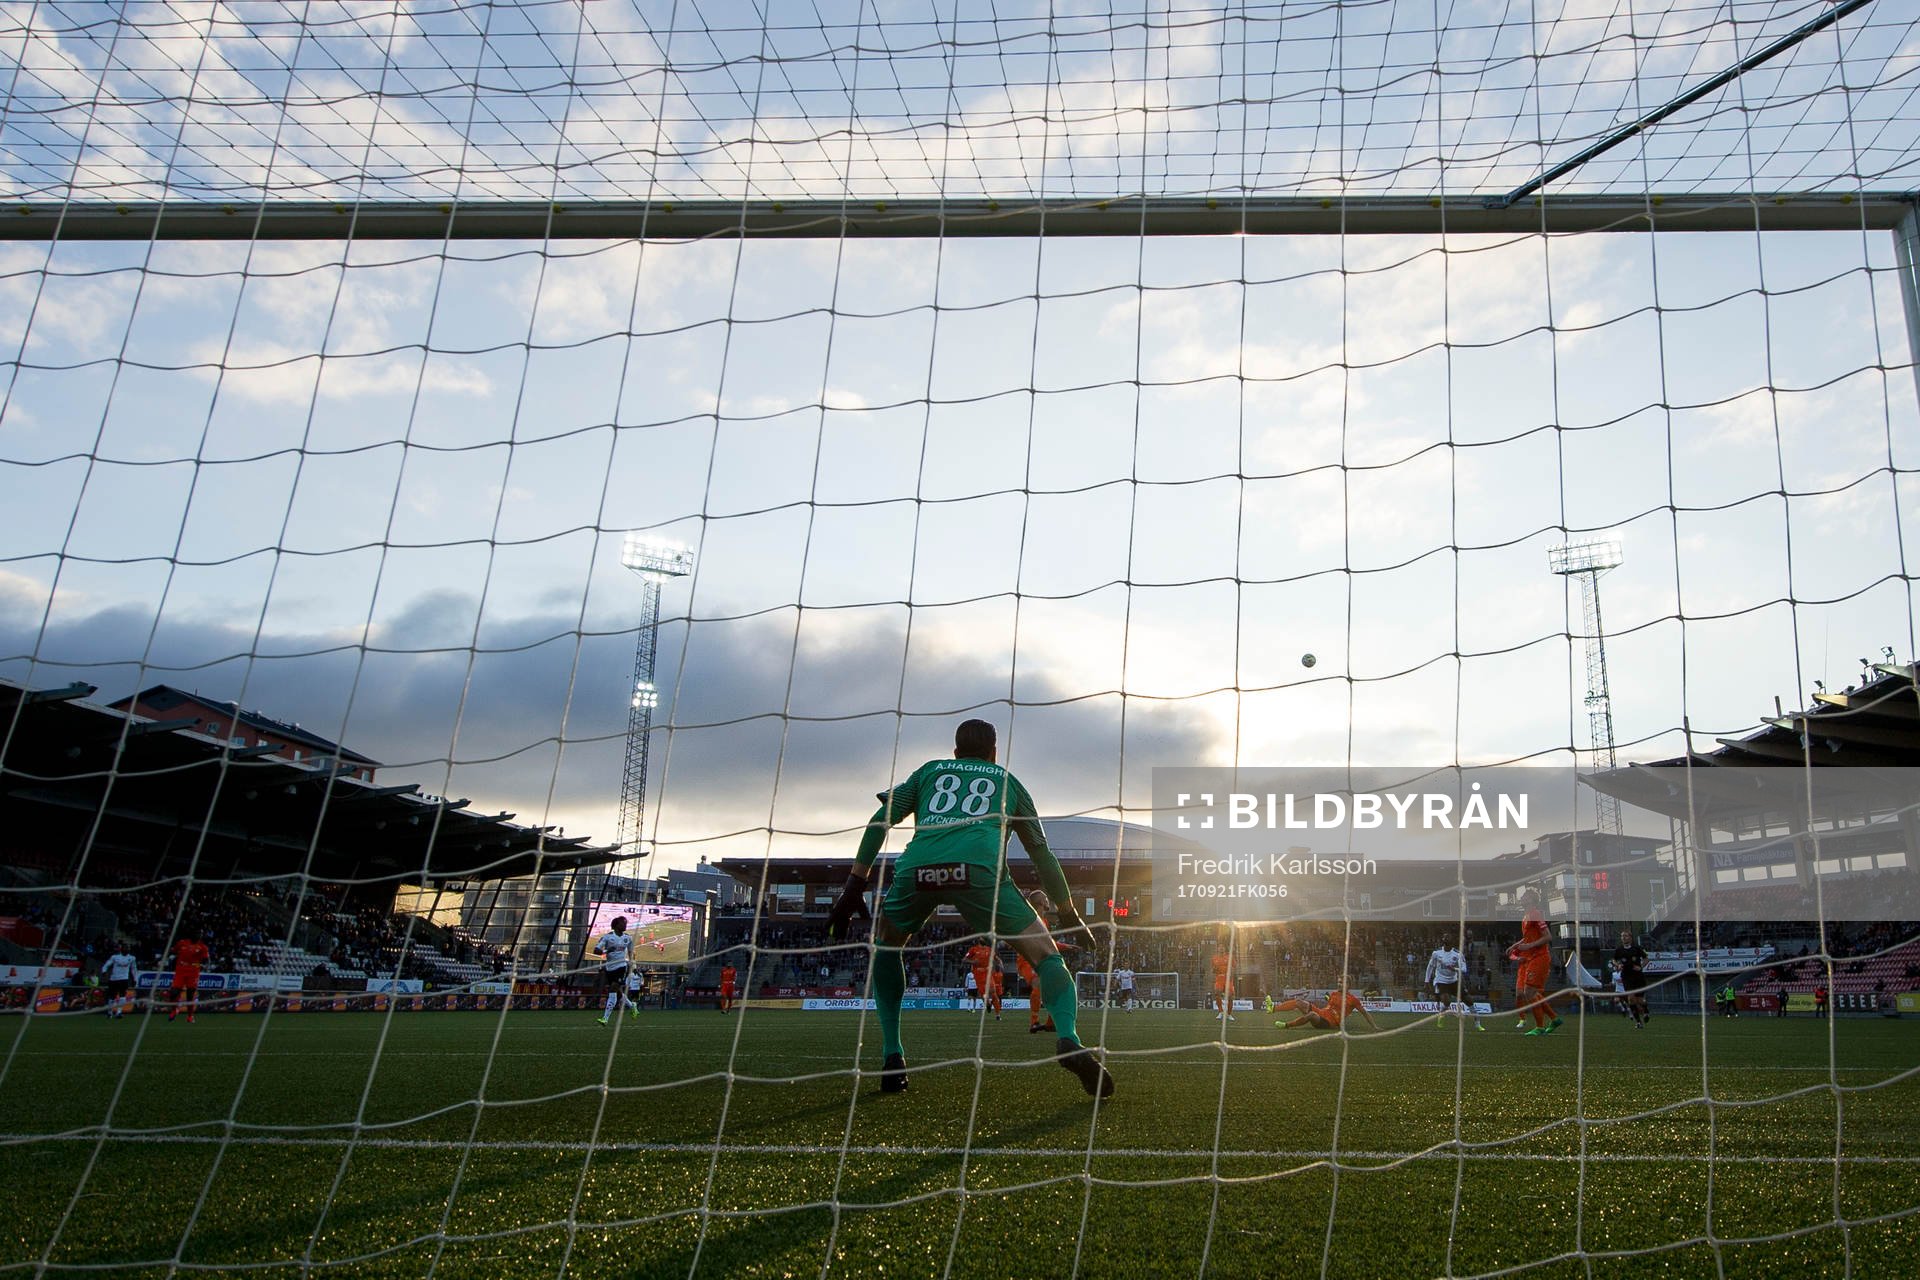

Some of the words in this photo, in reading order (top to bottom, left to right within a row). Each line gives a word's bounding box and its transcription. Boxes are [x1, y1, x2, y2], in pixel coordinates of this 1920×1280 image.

[928, 773, 996, 817] 88
[1713, 852, 1733, 867] NA
[824, 999, 860, 1007] ORRBYS
